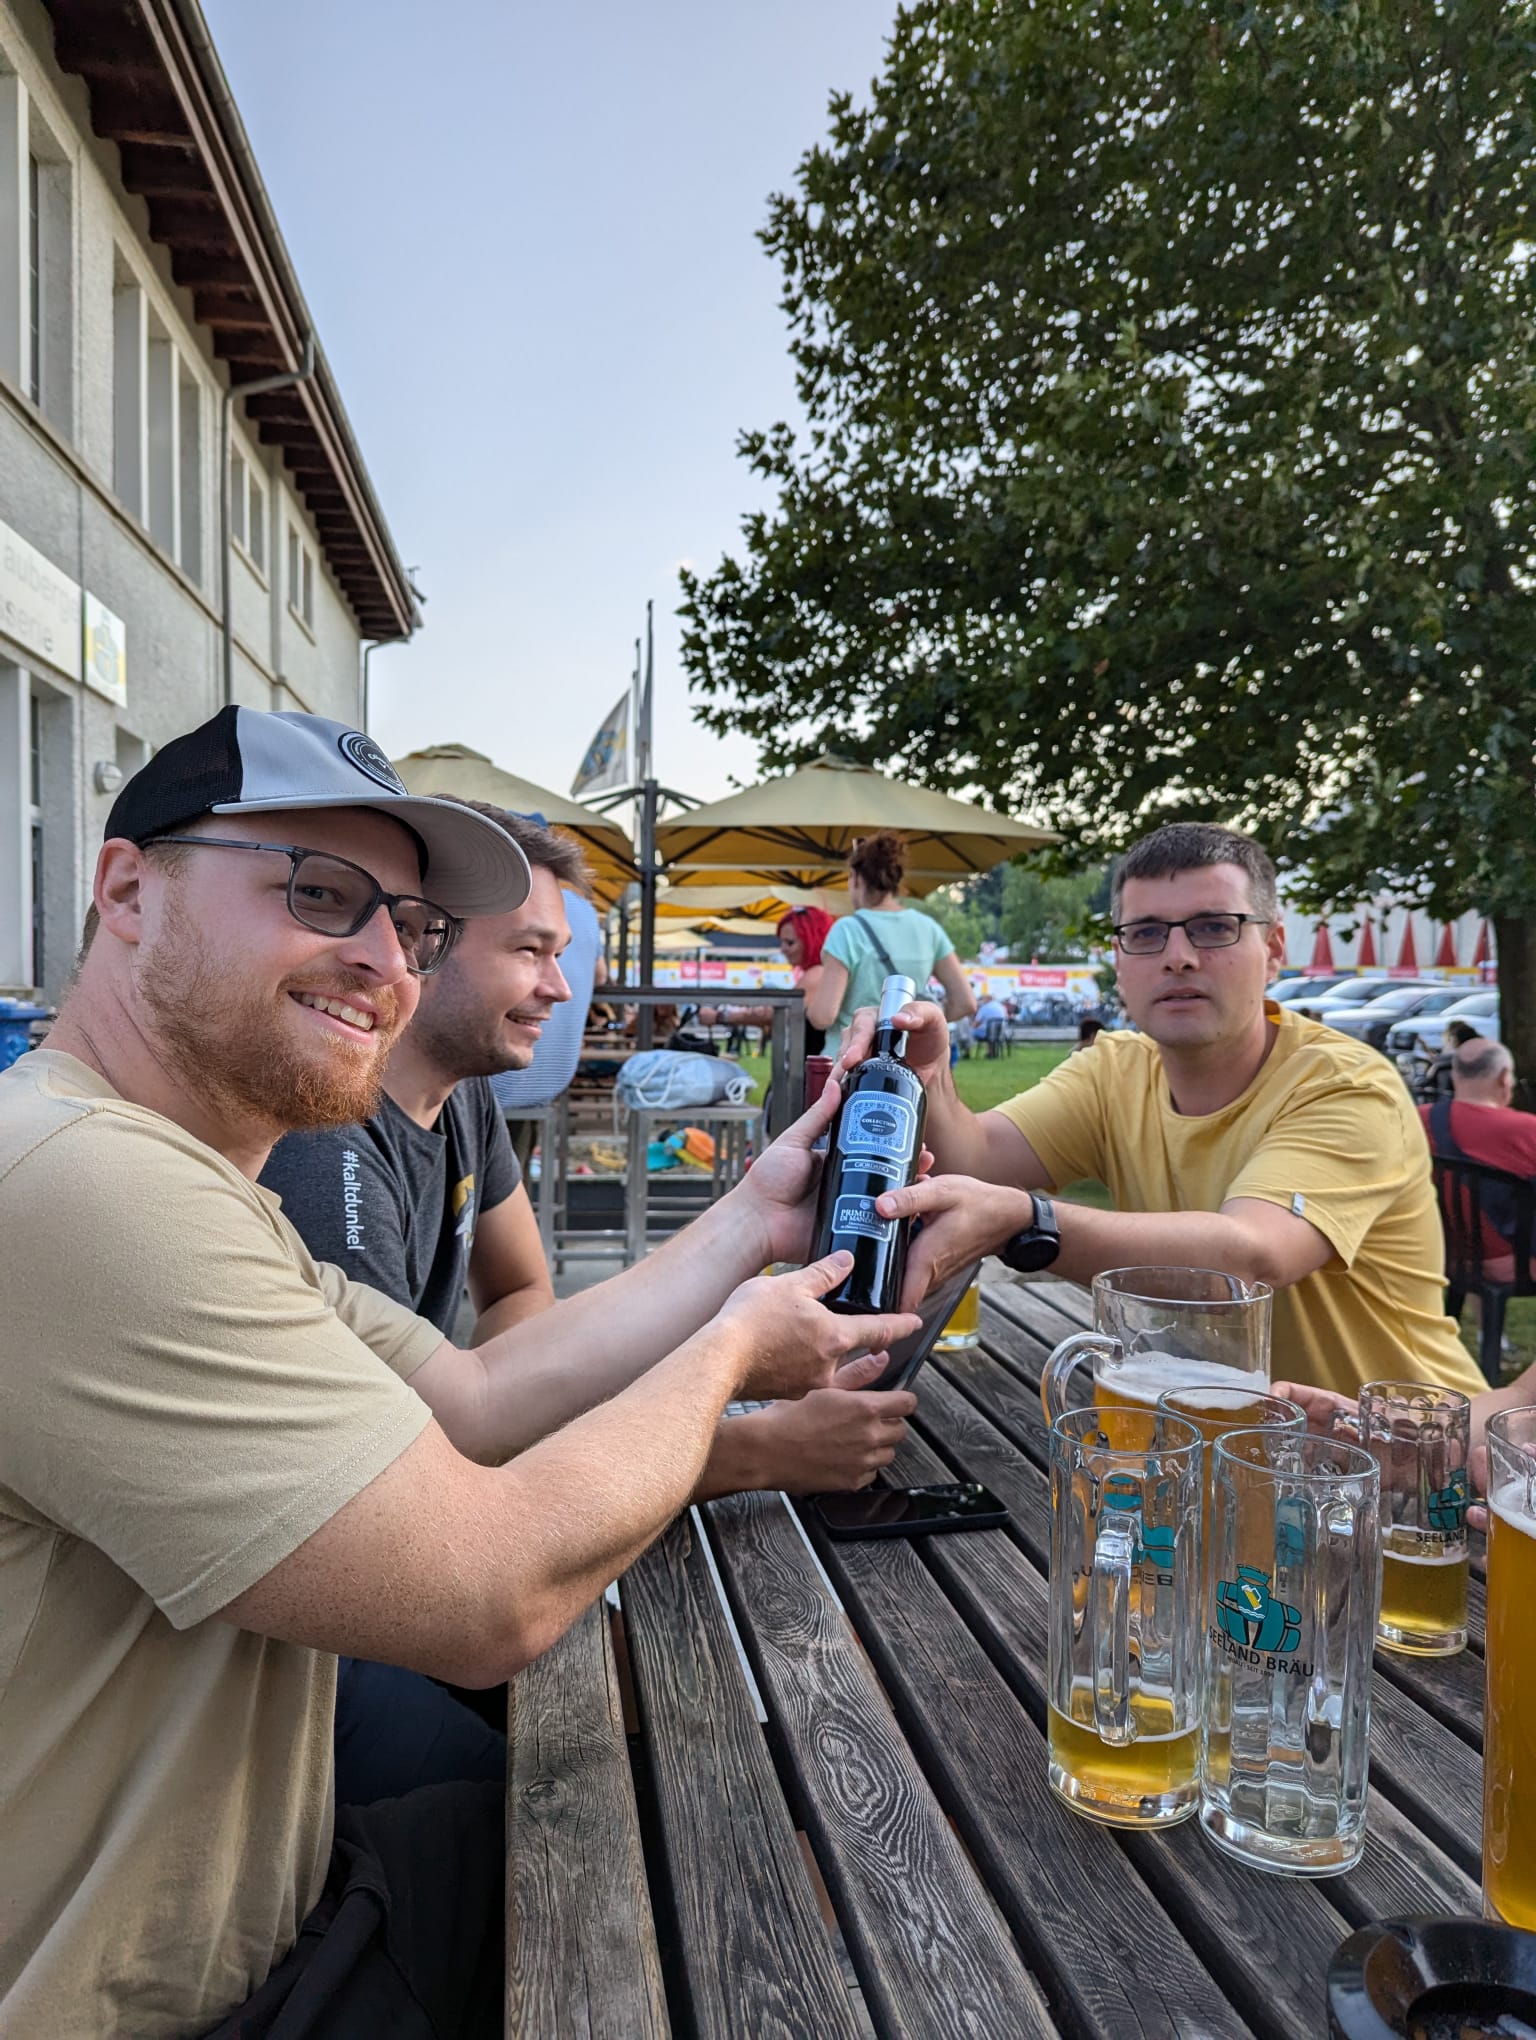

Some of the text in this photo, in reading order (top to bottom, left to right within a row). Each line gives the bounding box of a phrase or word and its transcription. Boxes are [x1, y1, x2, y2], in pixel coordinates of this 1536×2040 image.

[861, 1118, 896, 1128] COLLECTION
[343, 1150, 365, 1250] #kaltdunkel
[1209, 1626, 1314, 1677] SEELAND BRÄU
